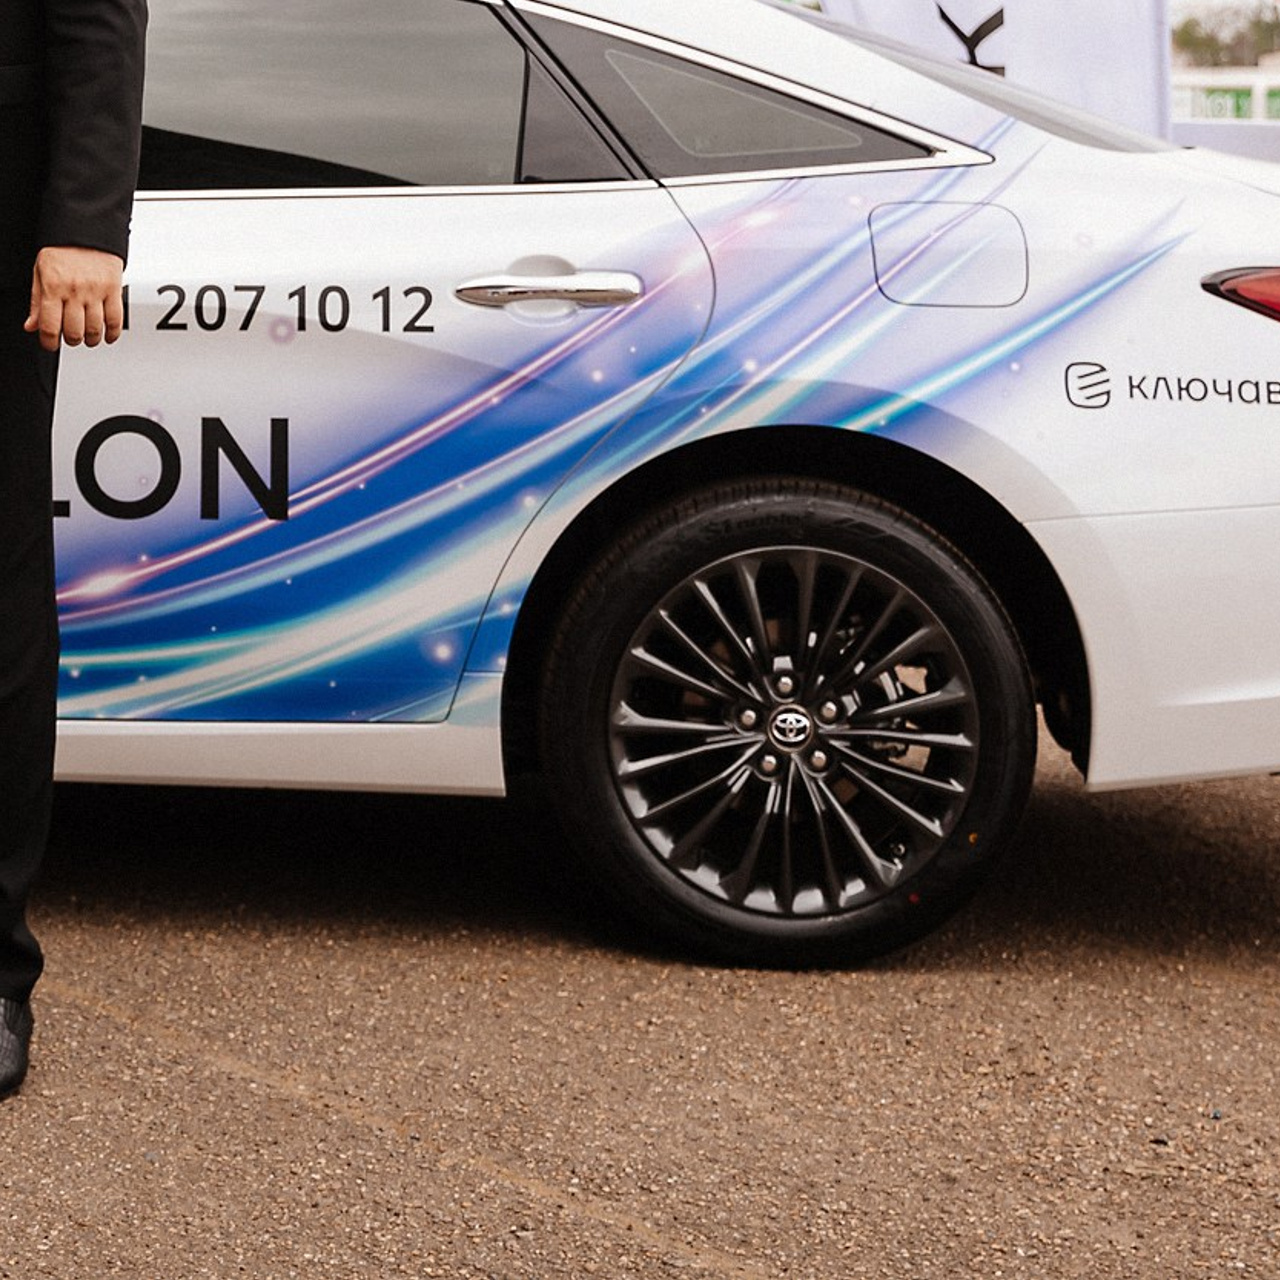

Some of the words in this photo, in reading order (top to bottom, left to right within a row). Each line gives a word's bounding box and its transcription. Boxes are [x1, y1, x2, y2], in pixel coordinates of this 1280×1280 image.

[155, 284, 266, 331] 207
[288, 286, 350, 332] 10
[372, 286, 435, 333] 12
[53, 415, 289, 521] ON
